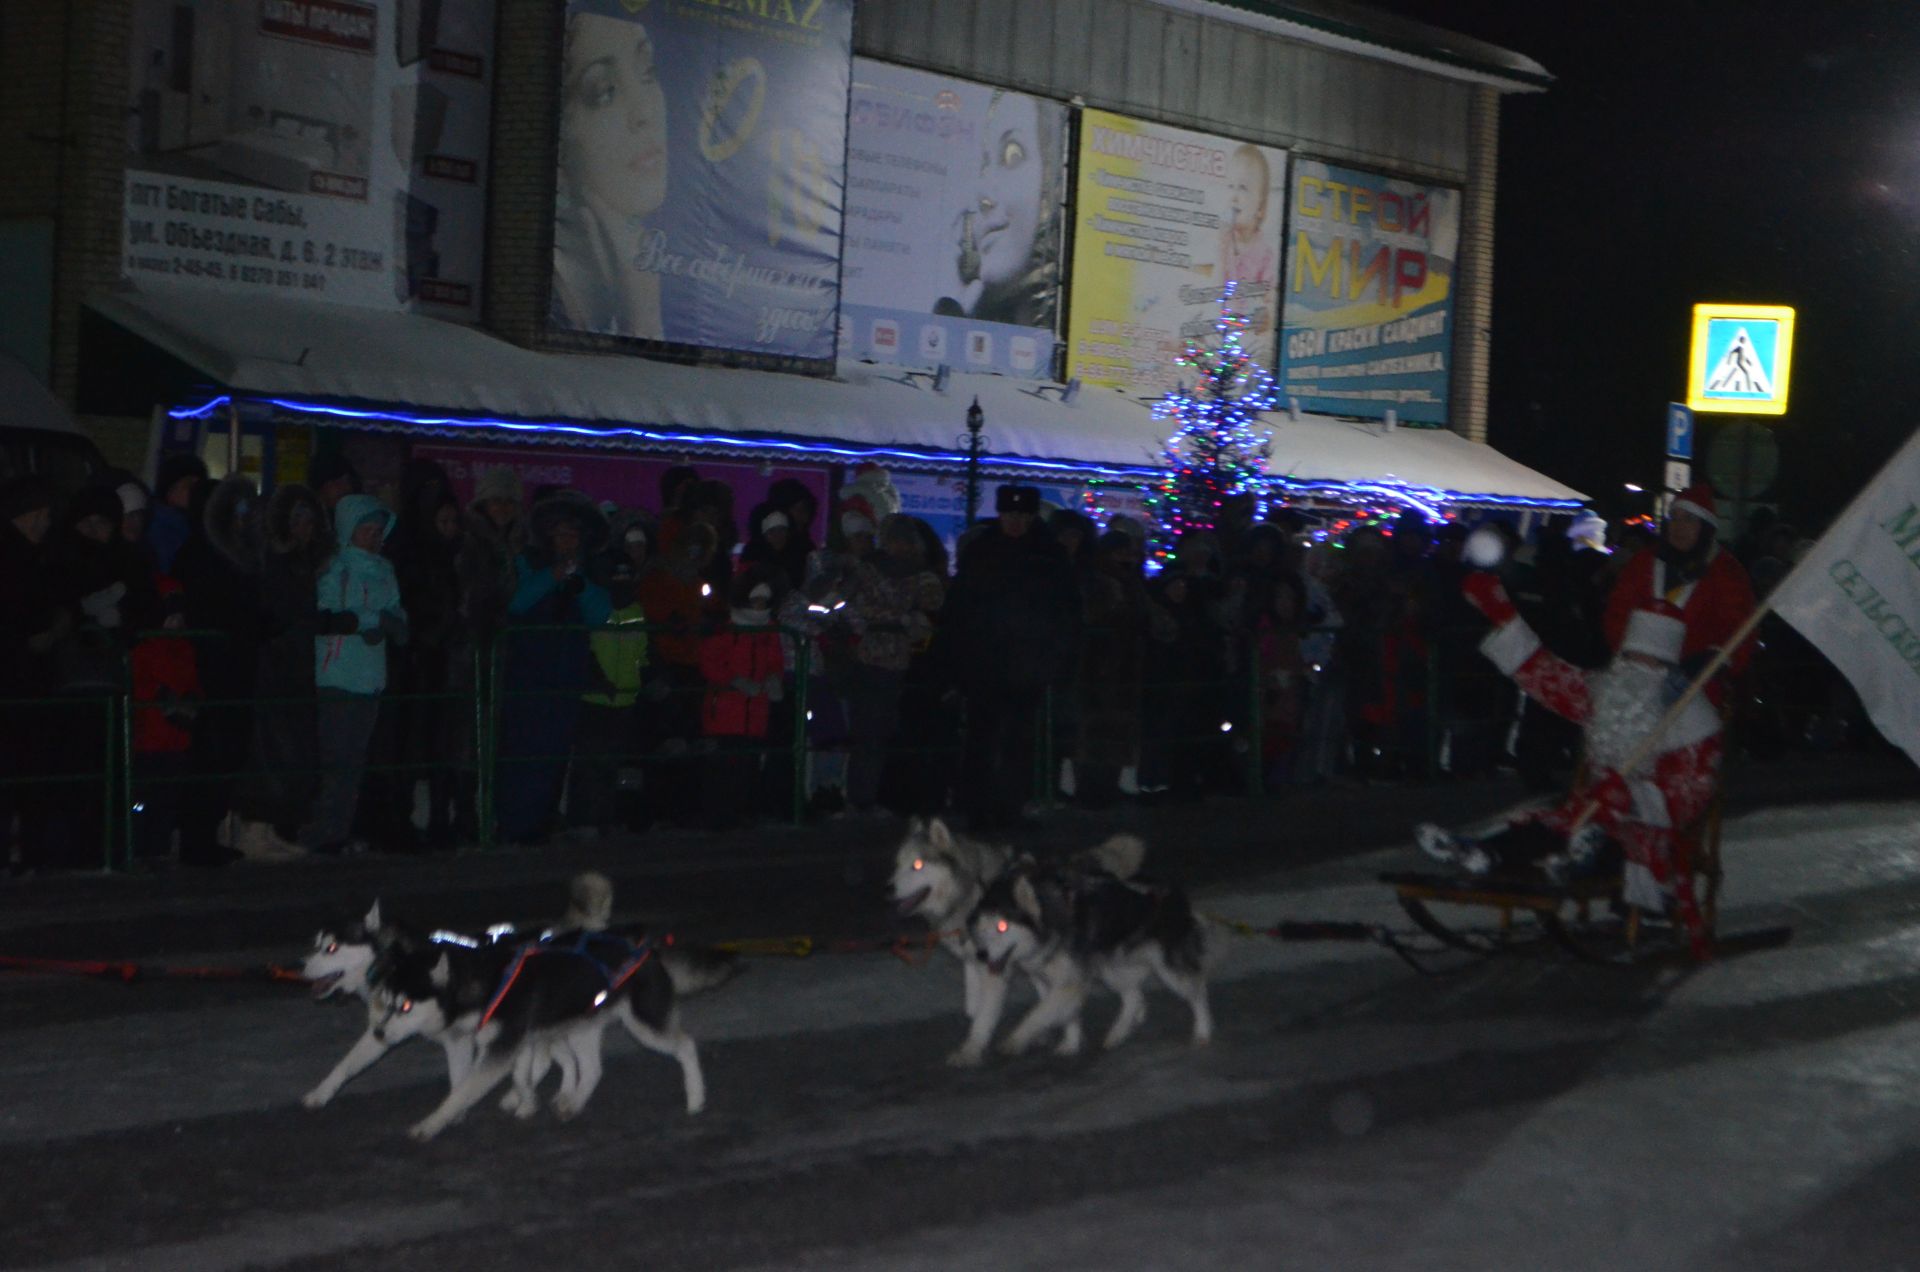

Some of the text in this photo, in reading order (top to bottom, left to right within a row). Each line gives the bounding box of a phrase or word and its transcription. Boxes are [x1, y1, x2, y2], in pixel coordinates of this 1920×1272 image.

[166, 184, 247, 221] Богатые
[1297, 175, 1430, 238] СТРОЙ
[1293, 231, 1428, 308] МИР
[1829, 559, 1920, 677] СЕЛЬСКО
